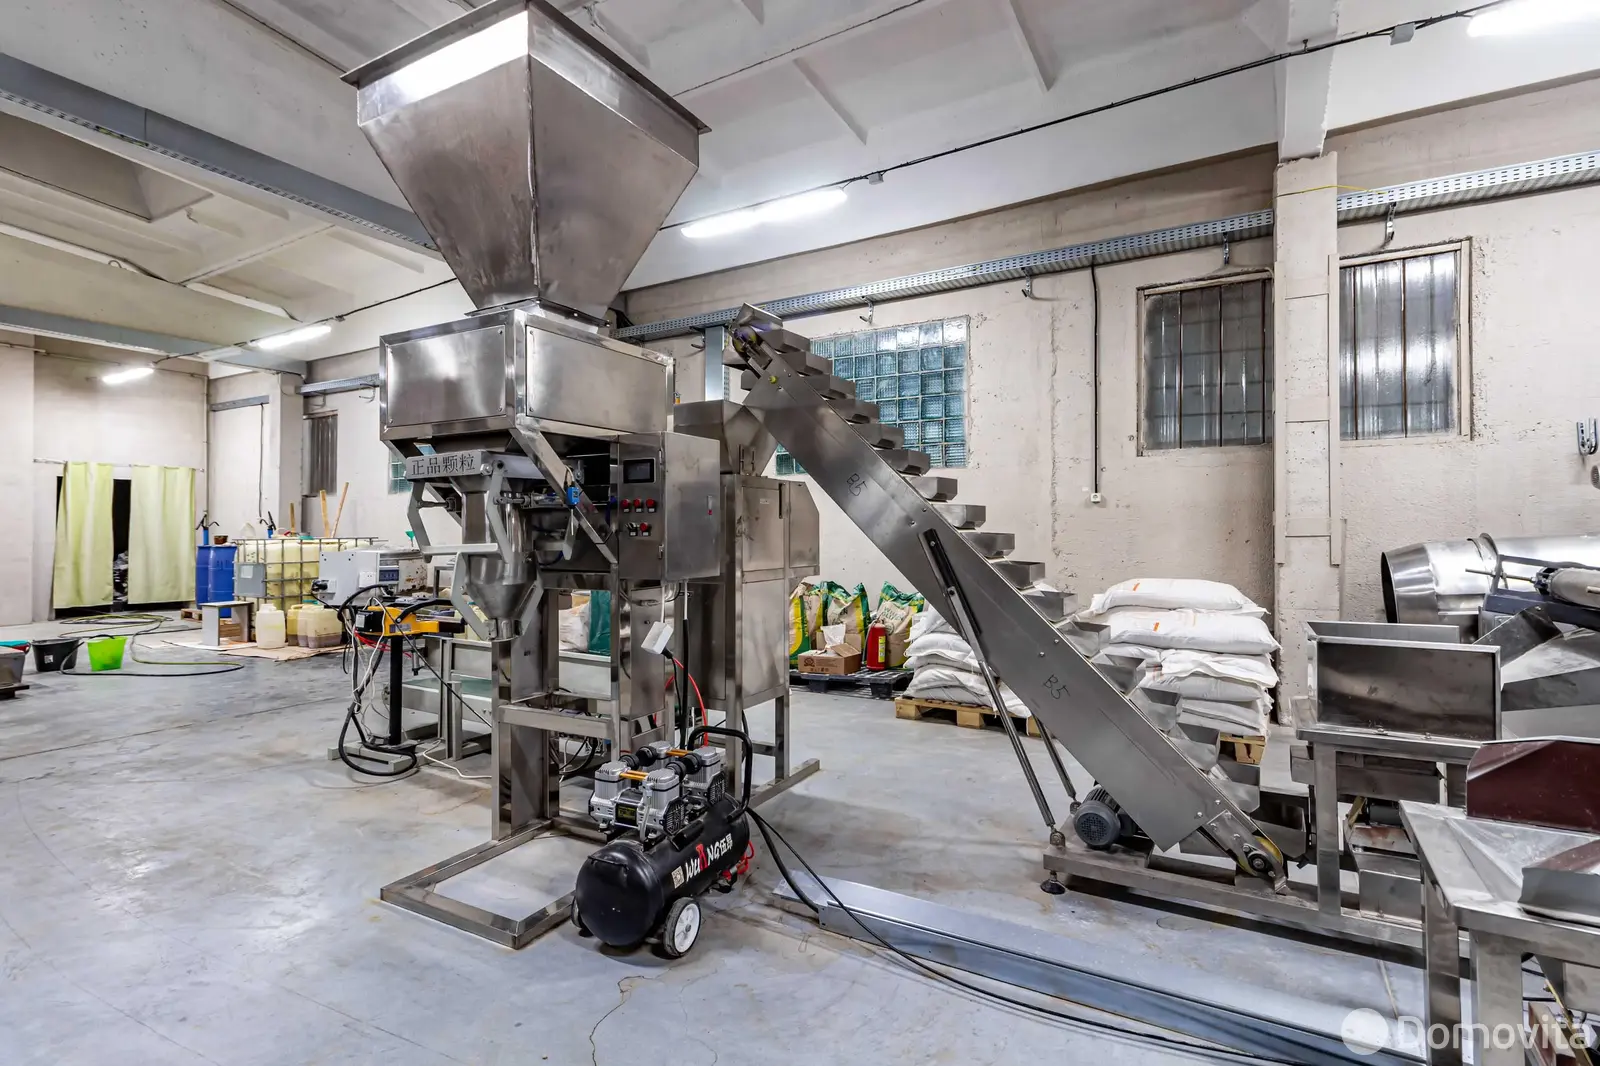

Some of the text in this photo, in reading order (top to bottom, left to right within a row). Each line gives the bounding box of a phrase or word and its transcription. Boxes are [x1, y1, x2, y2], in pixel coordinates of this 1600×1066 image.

[411, 453, 475, 476] 正品颗粒
[846, 472, 868, 497] B5
[1043, 674, 1071, 700] B5
